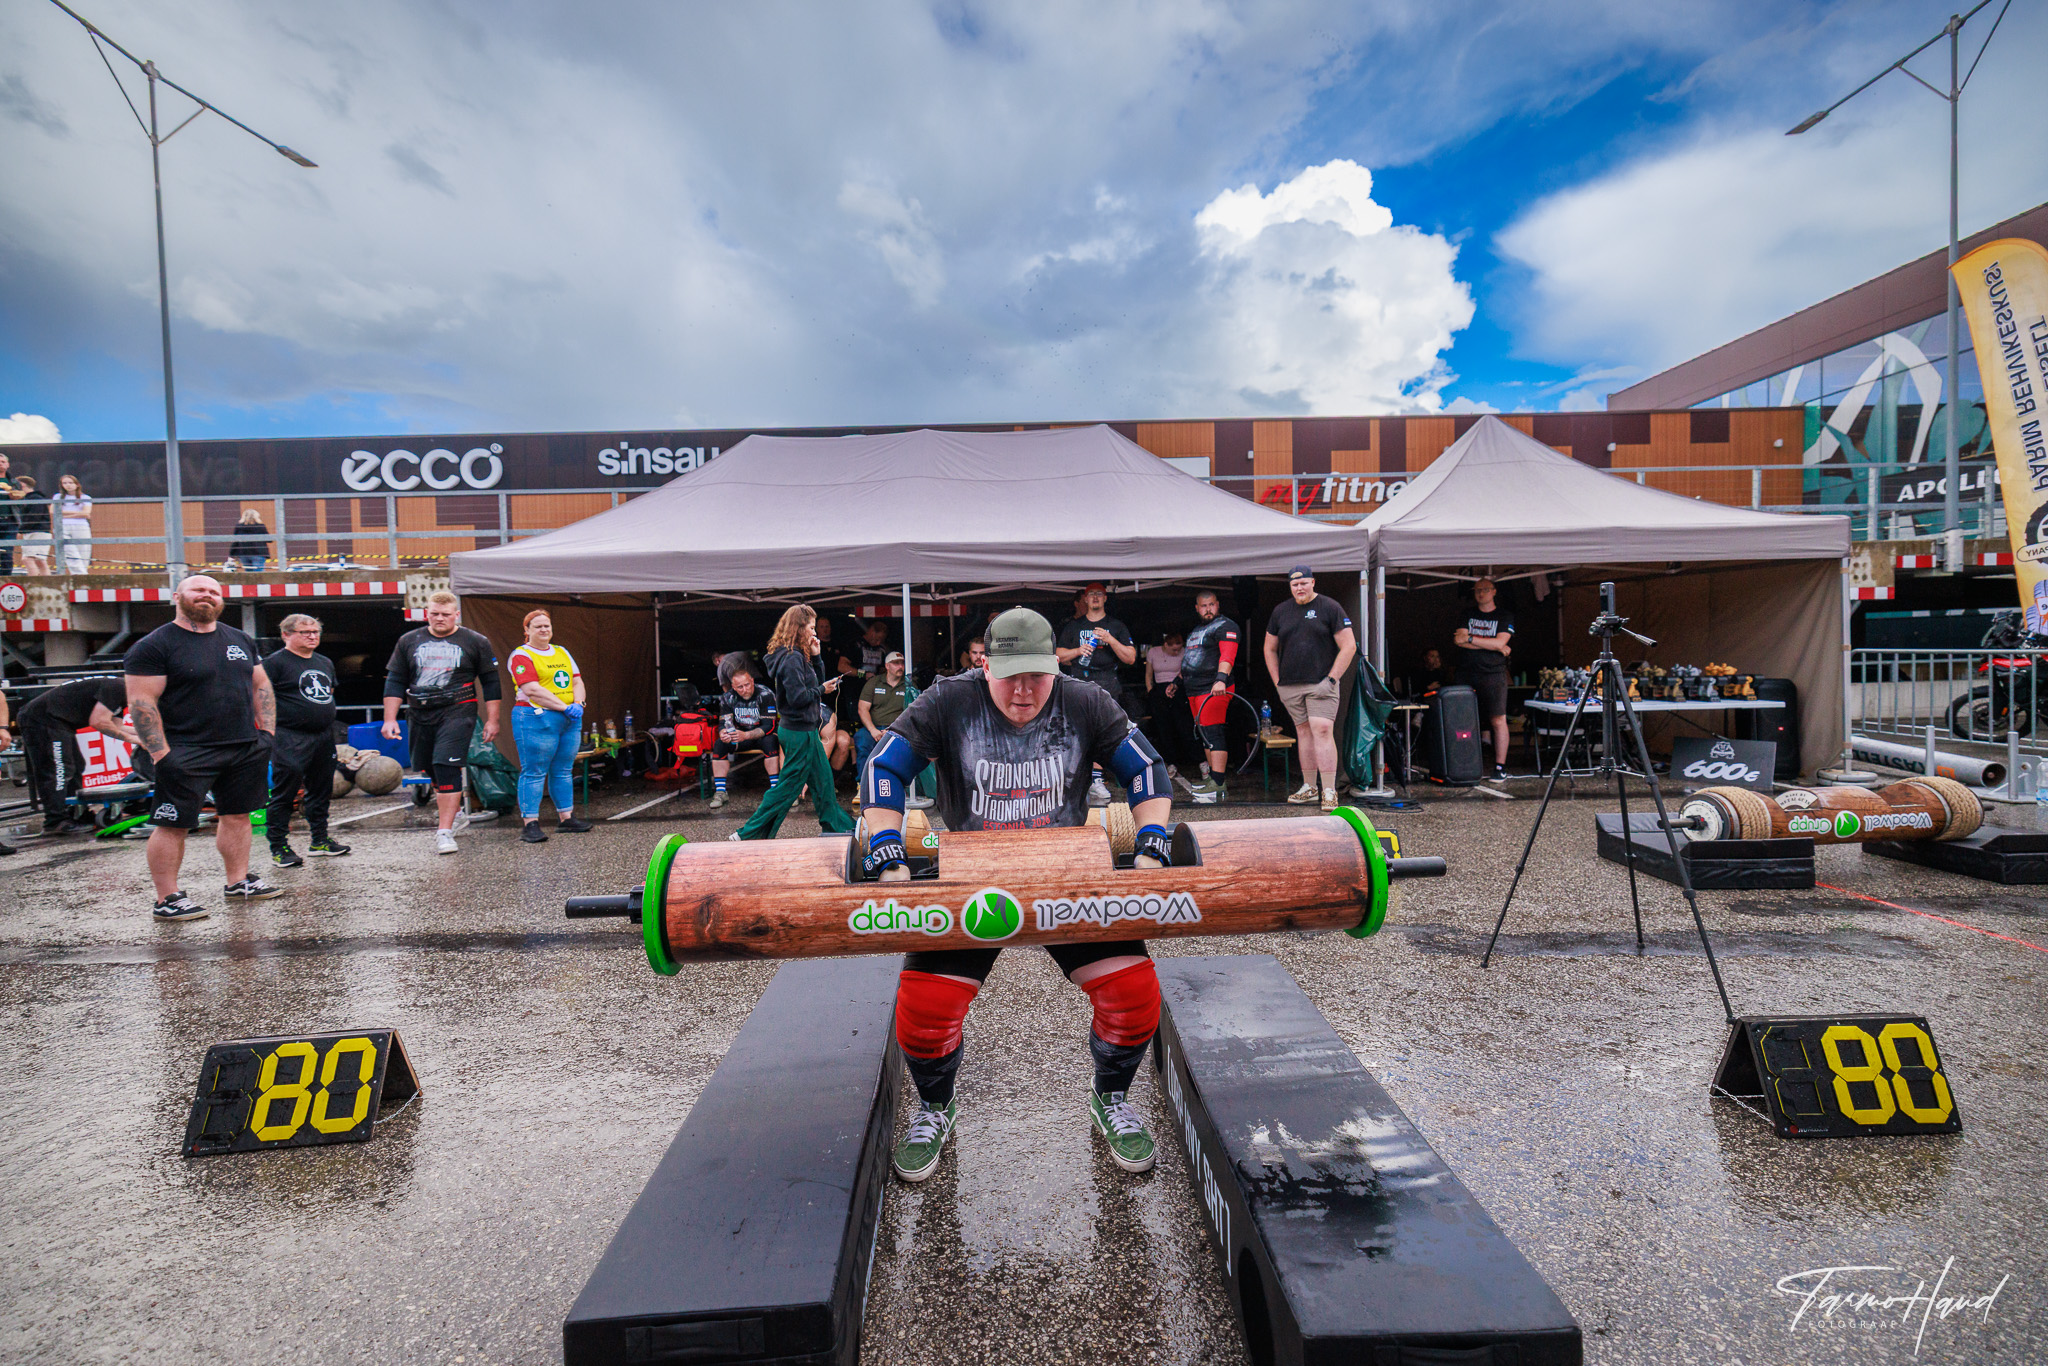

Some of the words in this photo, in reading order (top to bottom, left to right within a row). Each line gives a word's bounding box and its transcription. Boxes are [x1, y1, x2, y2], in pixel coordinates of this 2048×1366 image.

[341, 443, 503, 491] ecco
[75, 731, 138, 775] EK
[972, 754, 1065, 808] STRONGMAN
[1683, 760, 1760, 782] 600€
[972, 784, 1065, 822] STRONGWOMAN
[1011, 789, 1027, 799] PRO
[983, 820, 1026, 830] ESTONIA
[1790, 816, 1831, 833] Grupp
[1864, 813, 1932, 831] Woodwell
[852, 903, 949, 932] Grupp
[1036, 896, 1199, 928] Woodwell
[251, 1037, 377, 1142] 80
[1821, 1023, 1953, 1125] 80
